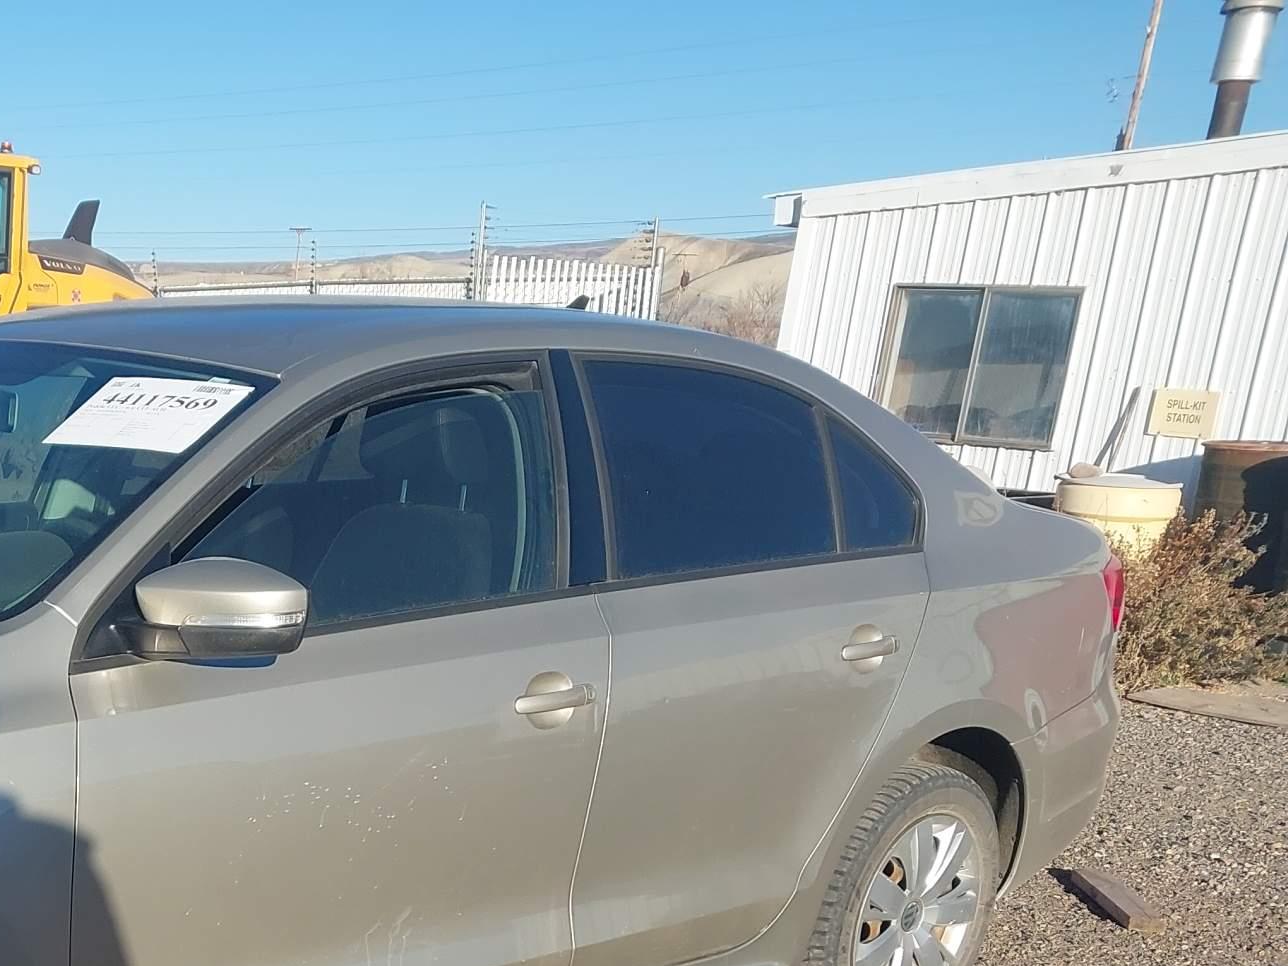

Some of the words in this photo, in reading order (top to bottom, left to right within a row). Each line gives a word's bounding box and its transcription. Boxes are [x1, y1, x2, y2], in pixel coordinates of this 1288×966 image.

[42, 259, 81, 271] VOLVO
[103, 392, 218, 411] 44117569
[1166, 398, 1207, 411] SPILL-KIT
[1165, 412, 1202, 425] STATION
